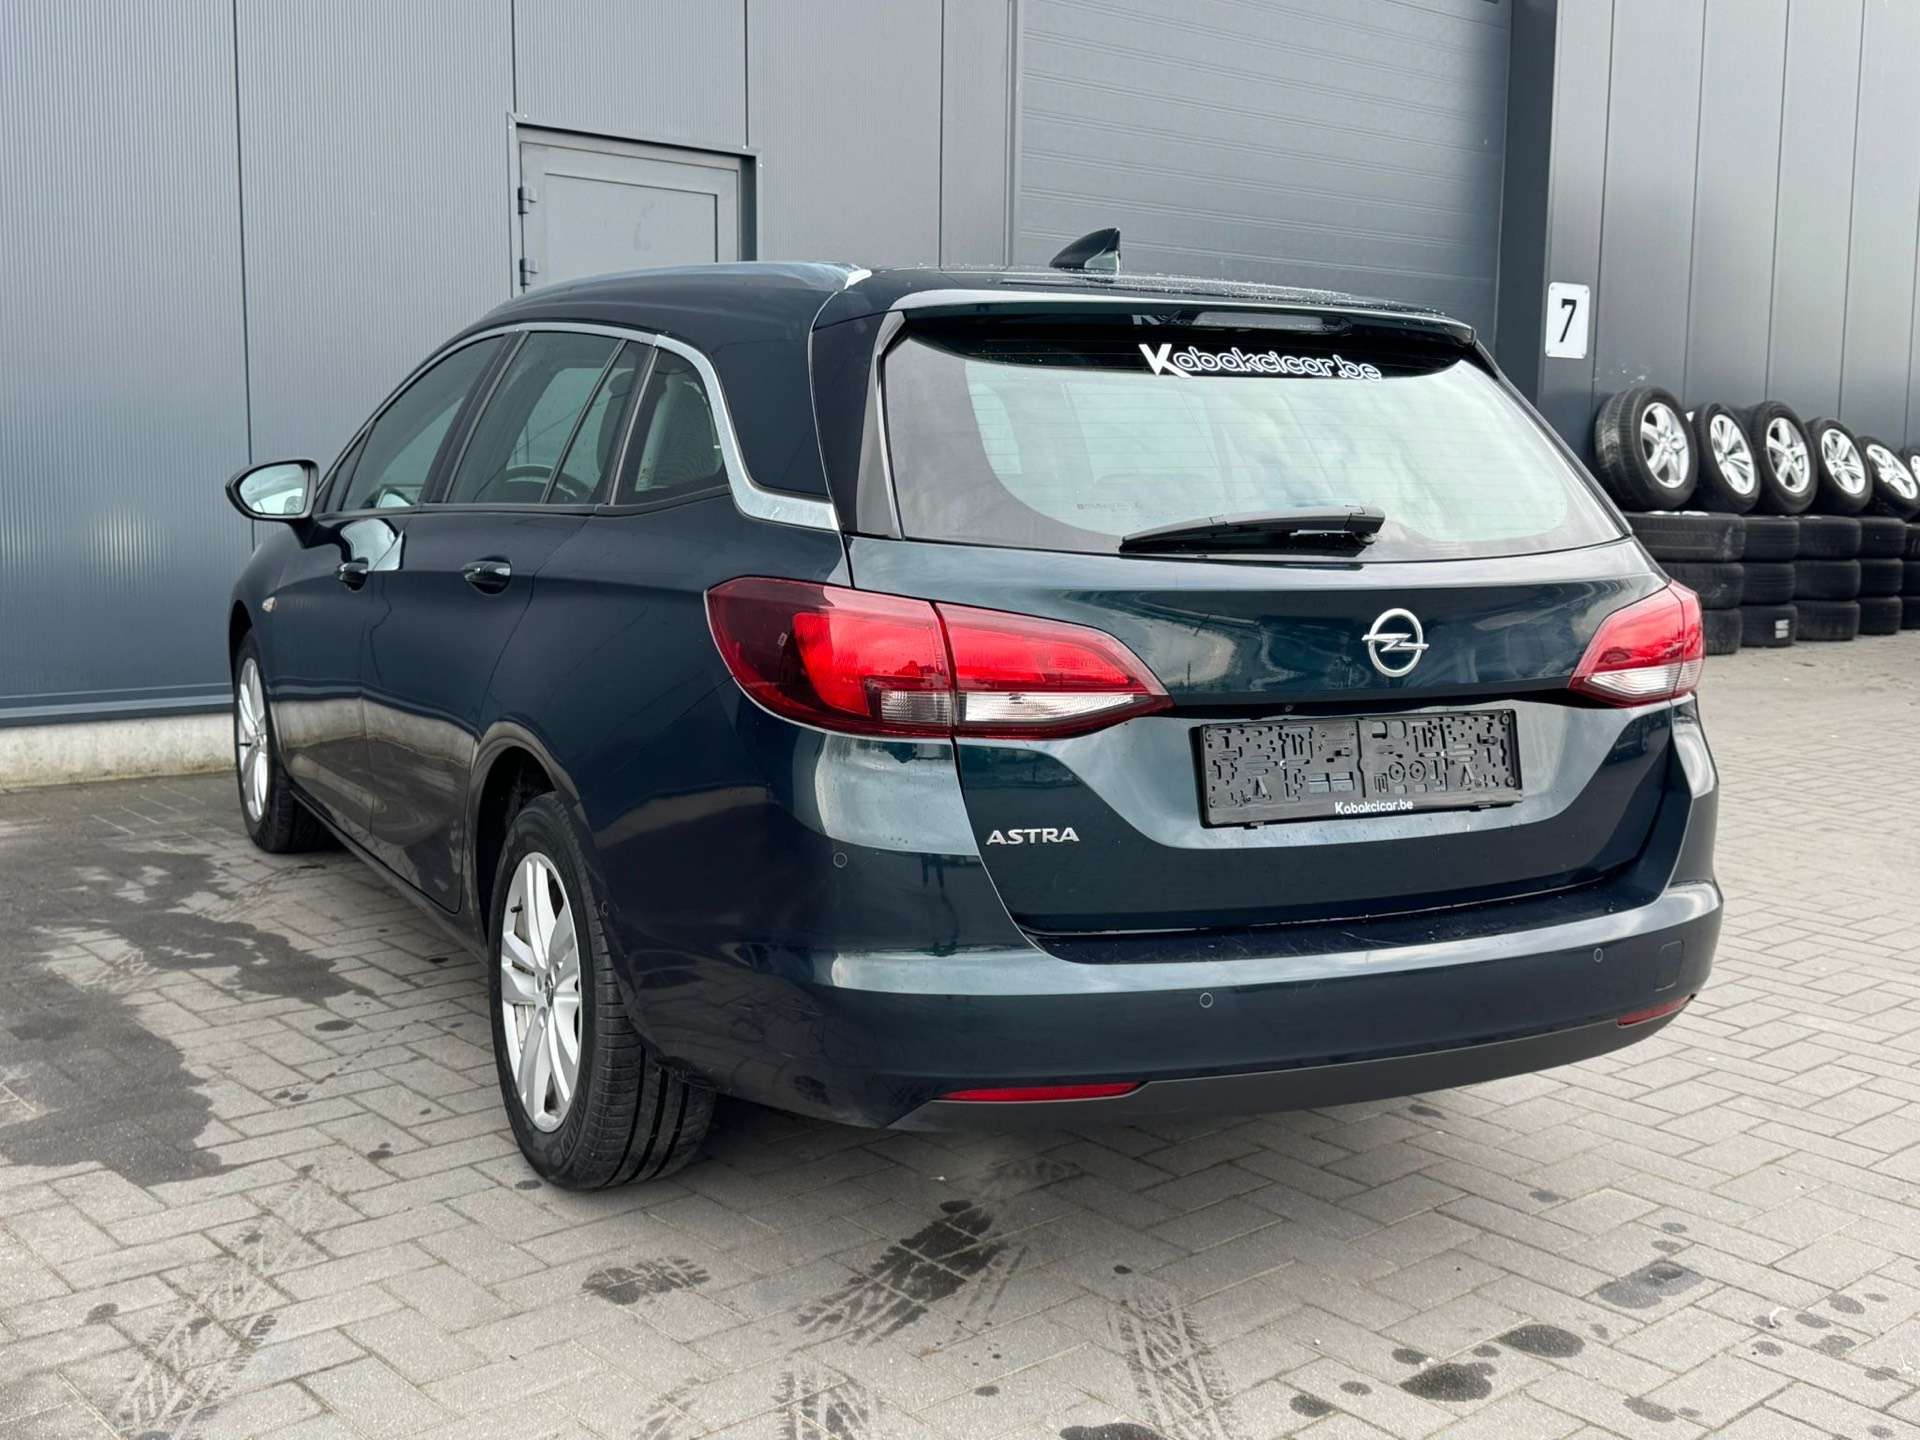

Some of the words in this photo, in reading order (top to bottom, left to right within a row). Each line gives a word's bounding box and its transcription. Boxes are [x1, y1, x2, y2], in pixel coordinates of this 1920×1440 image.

[1559, 298, 1577, 343] 7
[1138, 343, 1383, 381] Kabakcicar.be
[986, 827, 1080, 845] ASTRA
